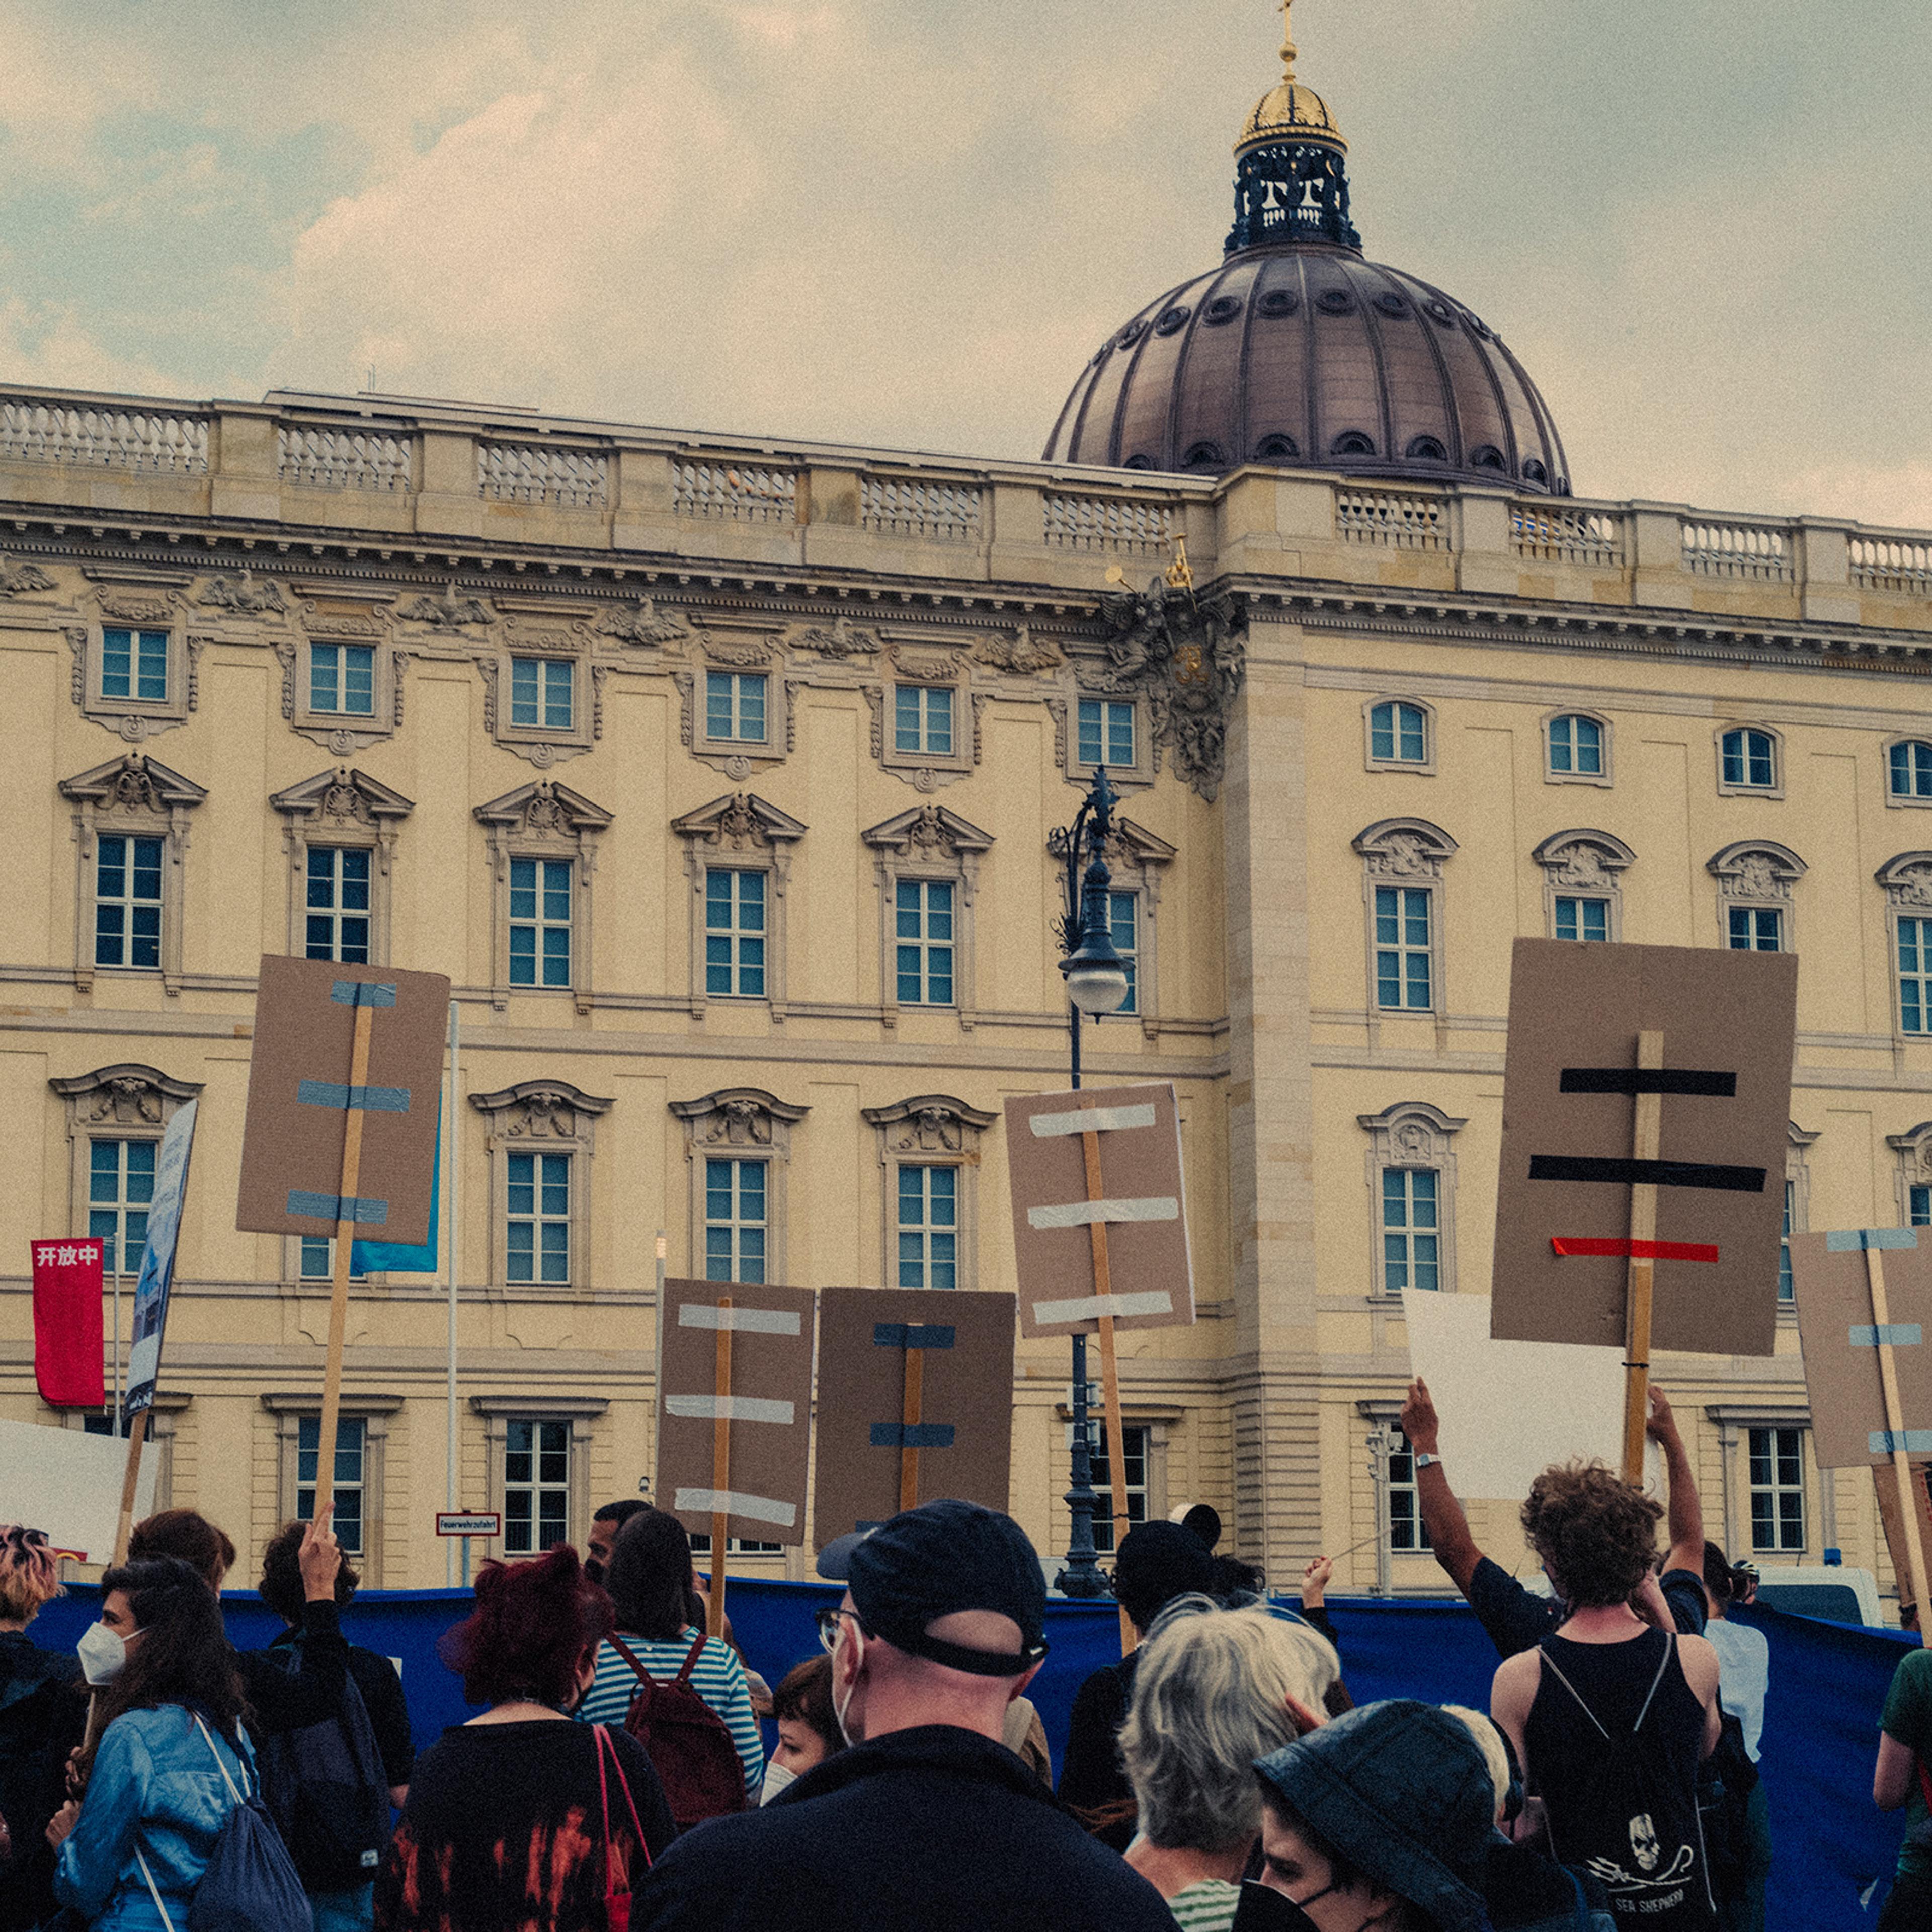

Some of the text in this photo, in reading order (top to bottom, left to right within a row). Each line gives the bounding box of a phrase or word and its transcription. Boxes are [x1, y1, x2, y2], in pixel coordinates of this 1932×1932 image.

[37, 1245, 98, 1267] 开放中
[440, 1520, 495, 1528] Feuerwehrzufahrt
[1615, 1889, 1683, 1912] SEA SHEPHERD
